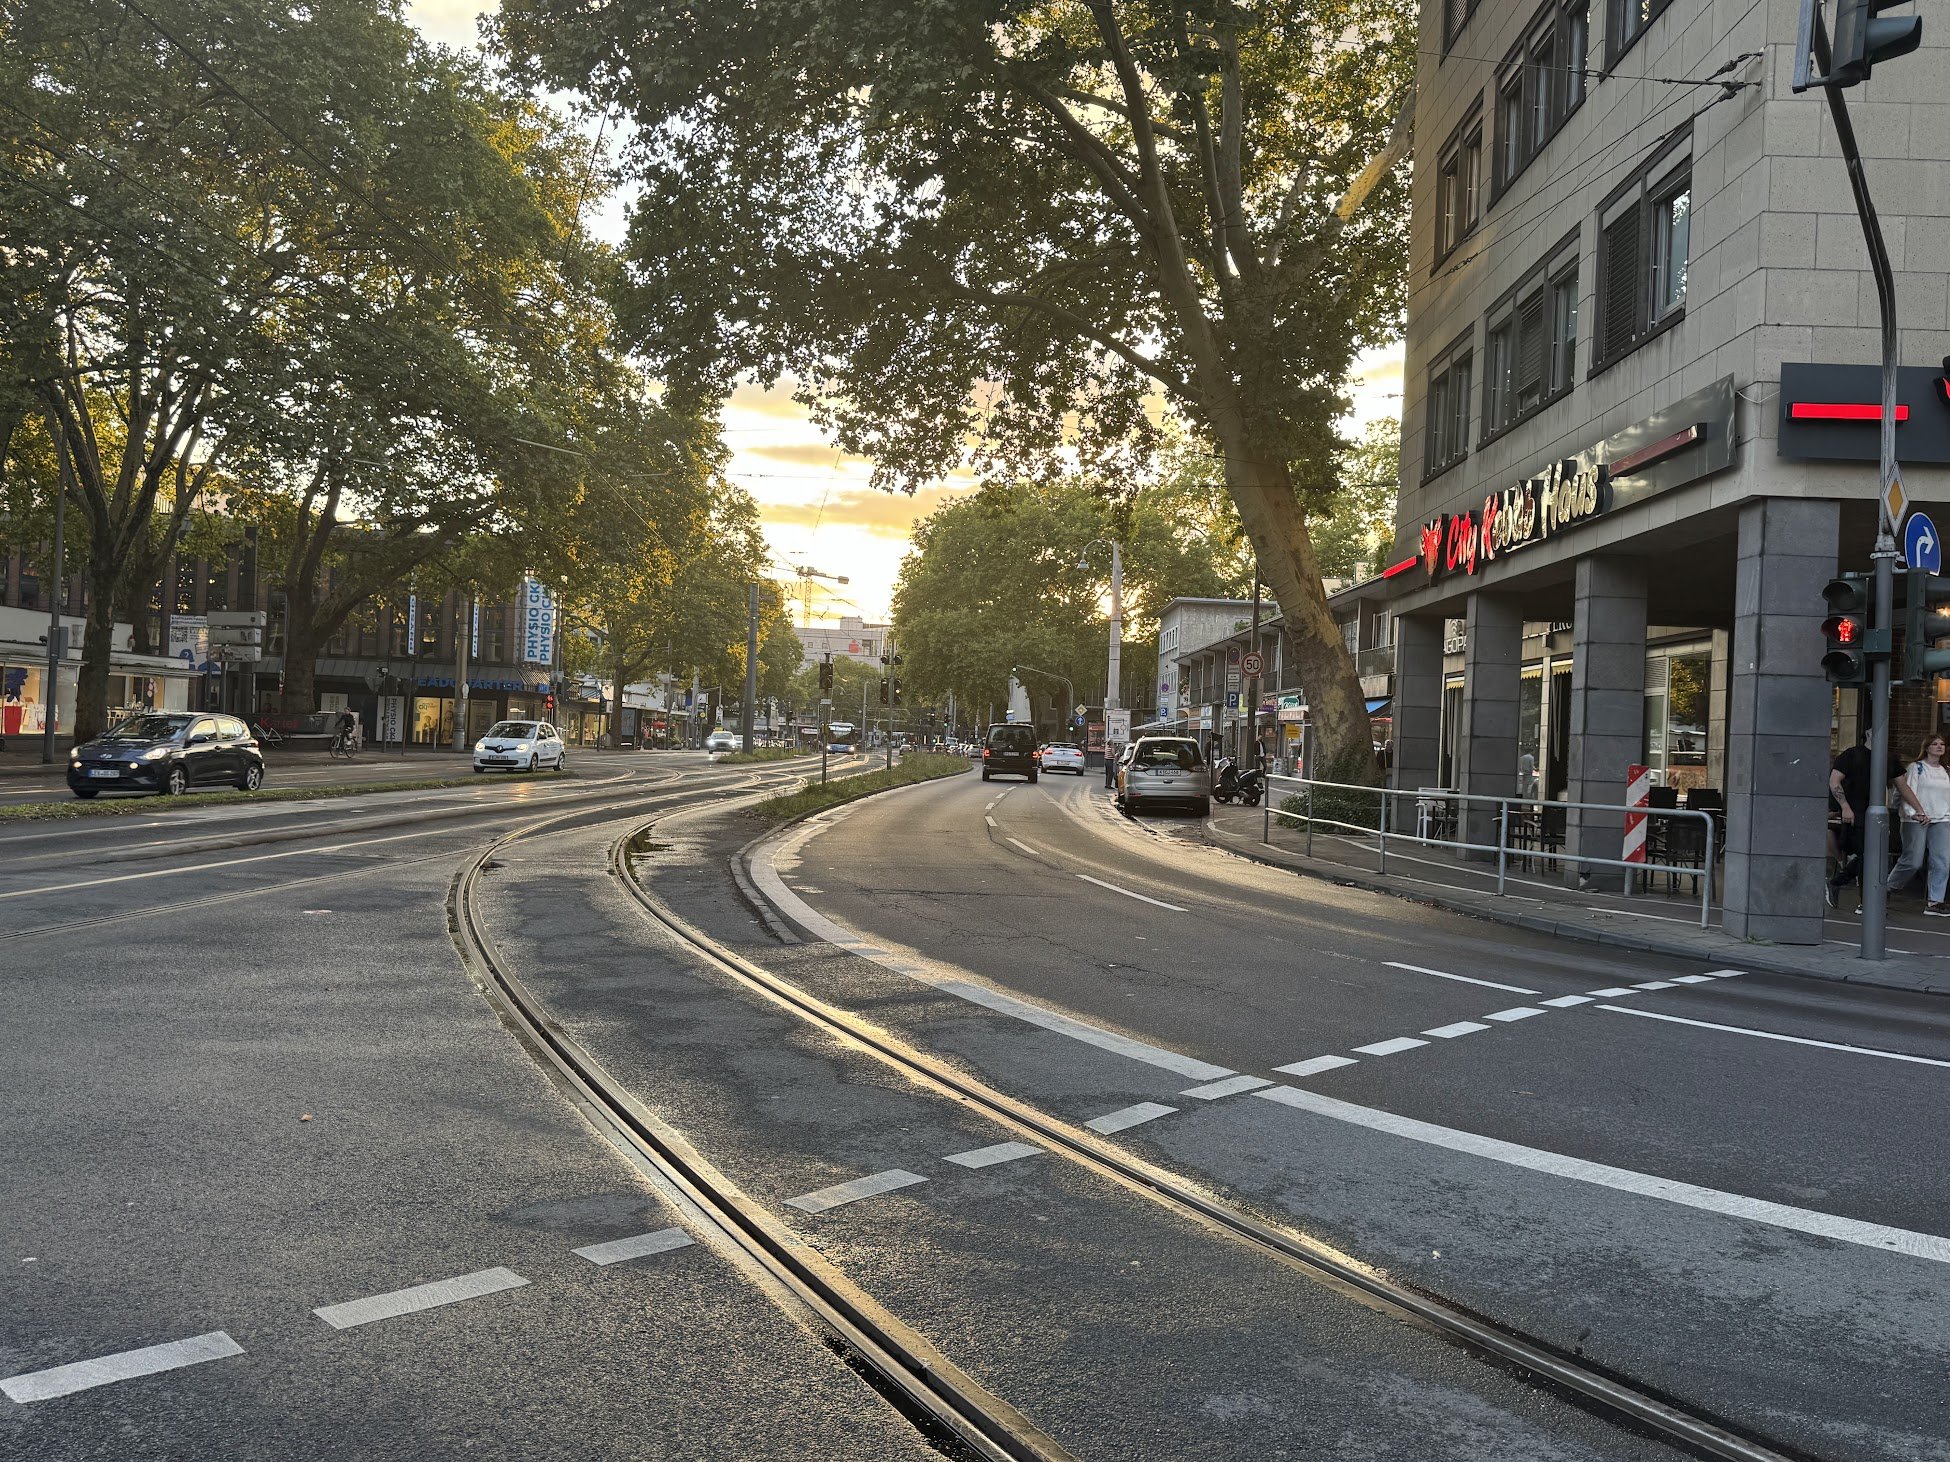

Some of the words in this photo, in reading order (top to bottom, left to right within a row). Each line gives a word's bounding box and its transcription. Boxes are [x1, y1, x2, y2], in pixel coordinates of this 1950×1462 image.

[1447, 511, 1478, 576] City
[1541, 458, 1599, 539] Haus
[527, 607, 540, 658] PHYSIO
[540, 612, 551, 662] PHYSIO
[1246, 659, 1259, 670] 50
[1229, 693, 1237, 707] P
